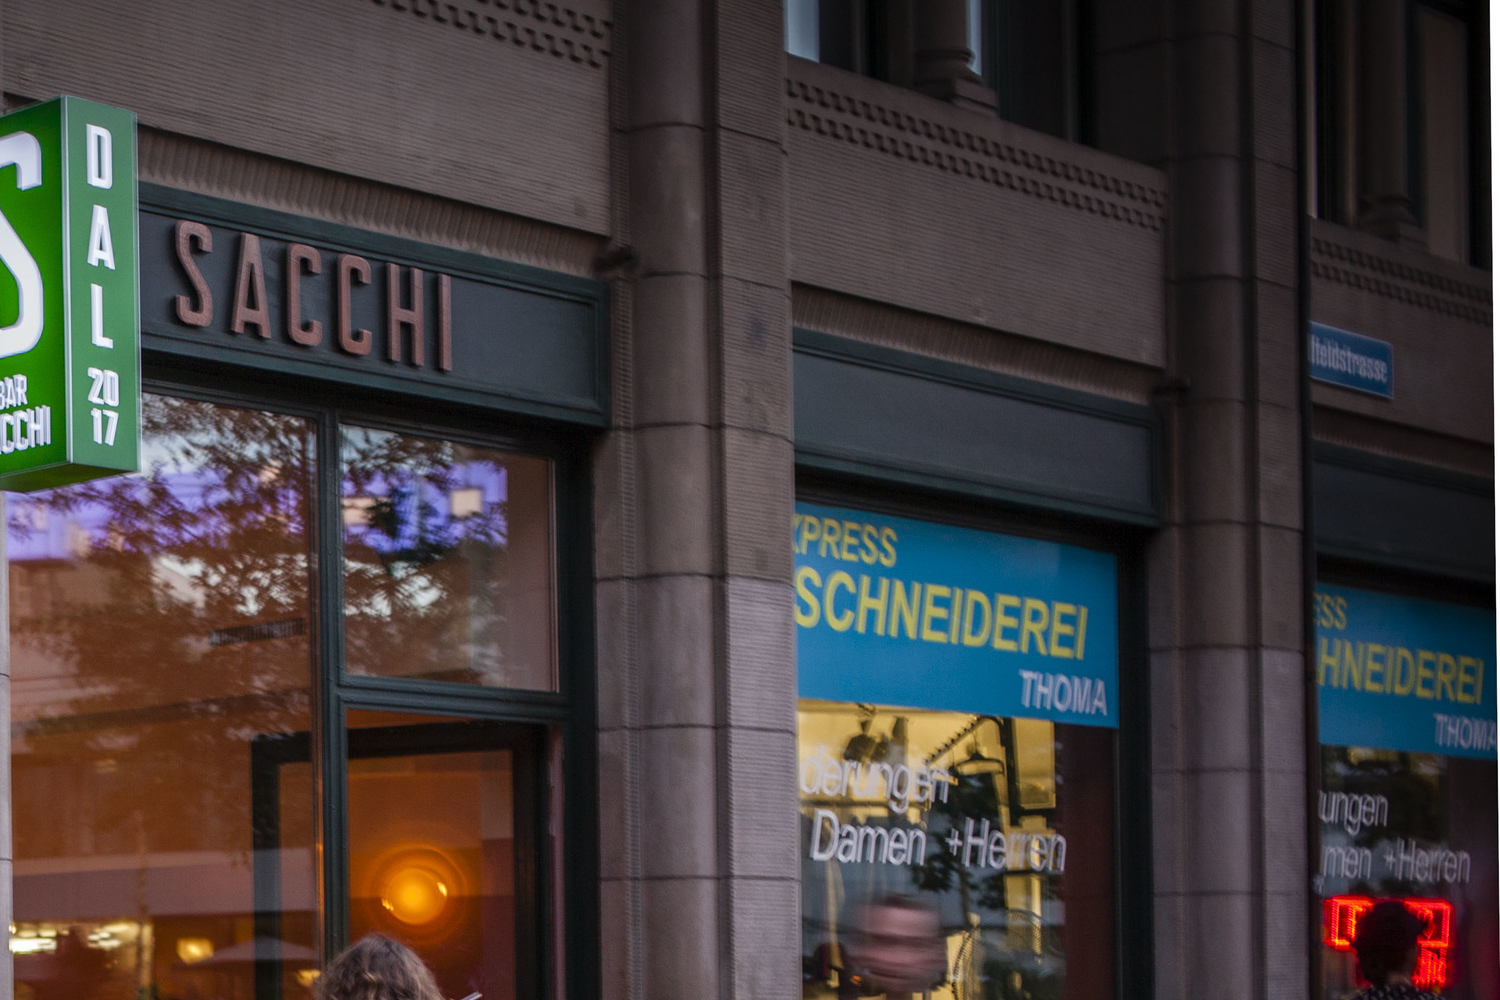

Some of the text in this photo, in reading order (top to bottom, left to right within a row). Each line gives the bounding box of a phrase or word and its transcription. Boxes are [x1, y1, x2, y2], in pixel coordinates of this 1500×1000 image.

[87, 123, 116, 350] DAL
[175, 220, 453, 372] SACCHI
[87, 367, 120, 407] 20
[91, 408, 119, 446] 17
[794, 567, 1089, 660] SCHNEIDEREI
[1019, 669, 1108, 716] THOMA
[1316, 636, 1485, 704] HNEIDEREI
[800, 744, 950, 814] derungen
[810, 809, 927, 866] Damen
